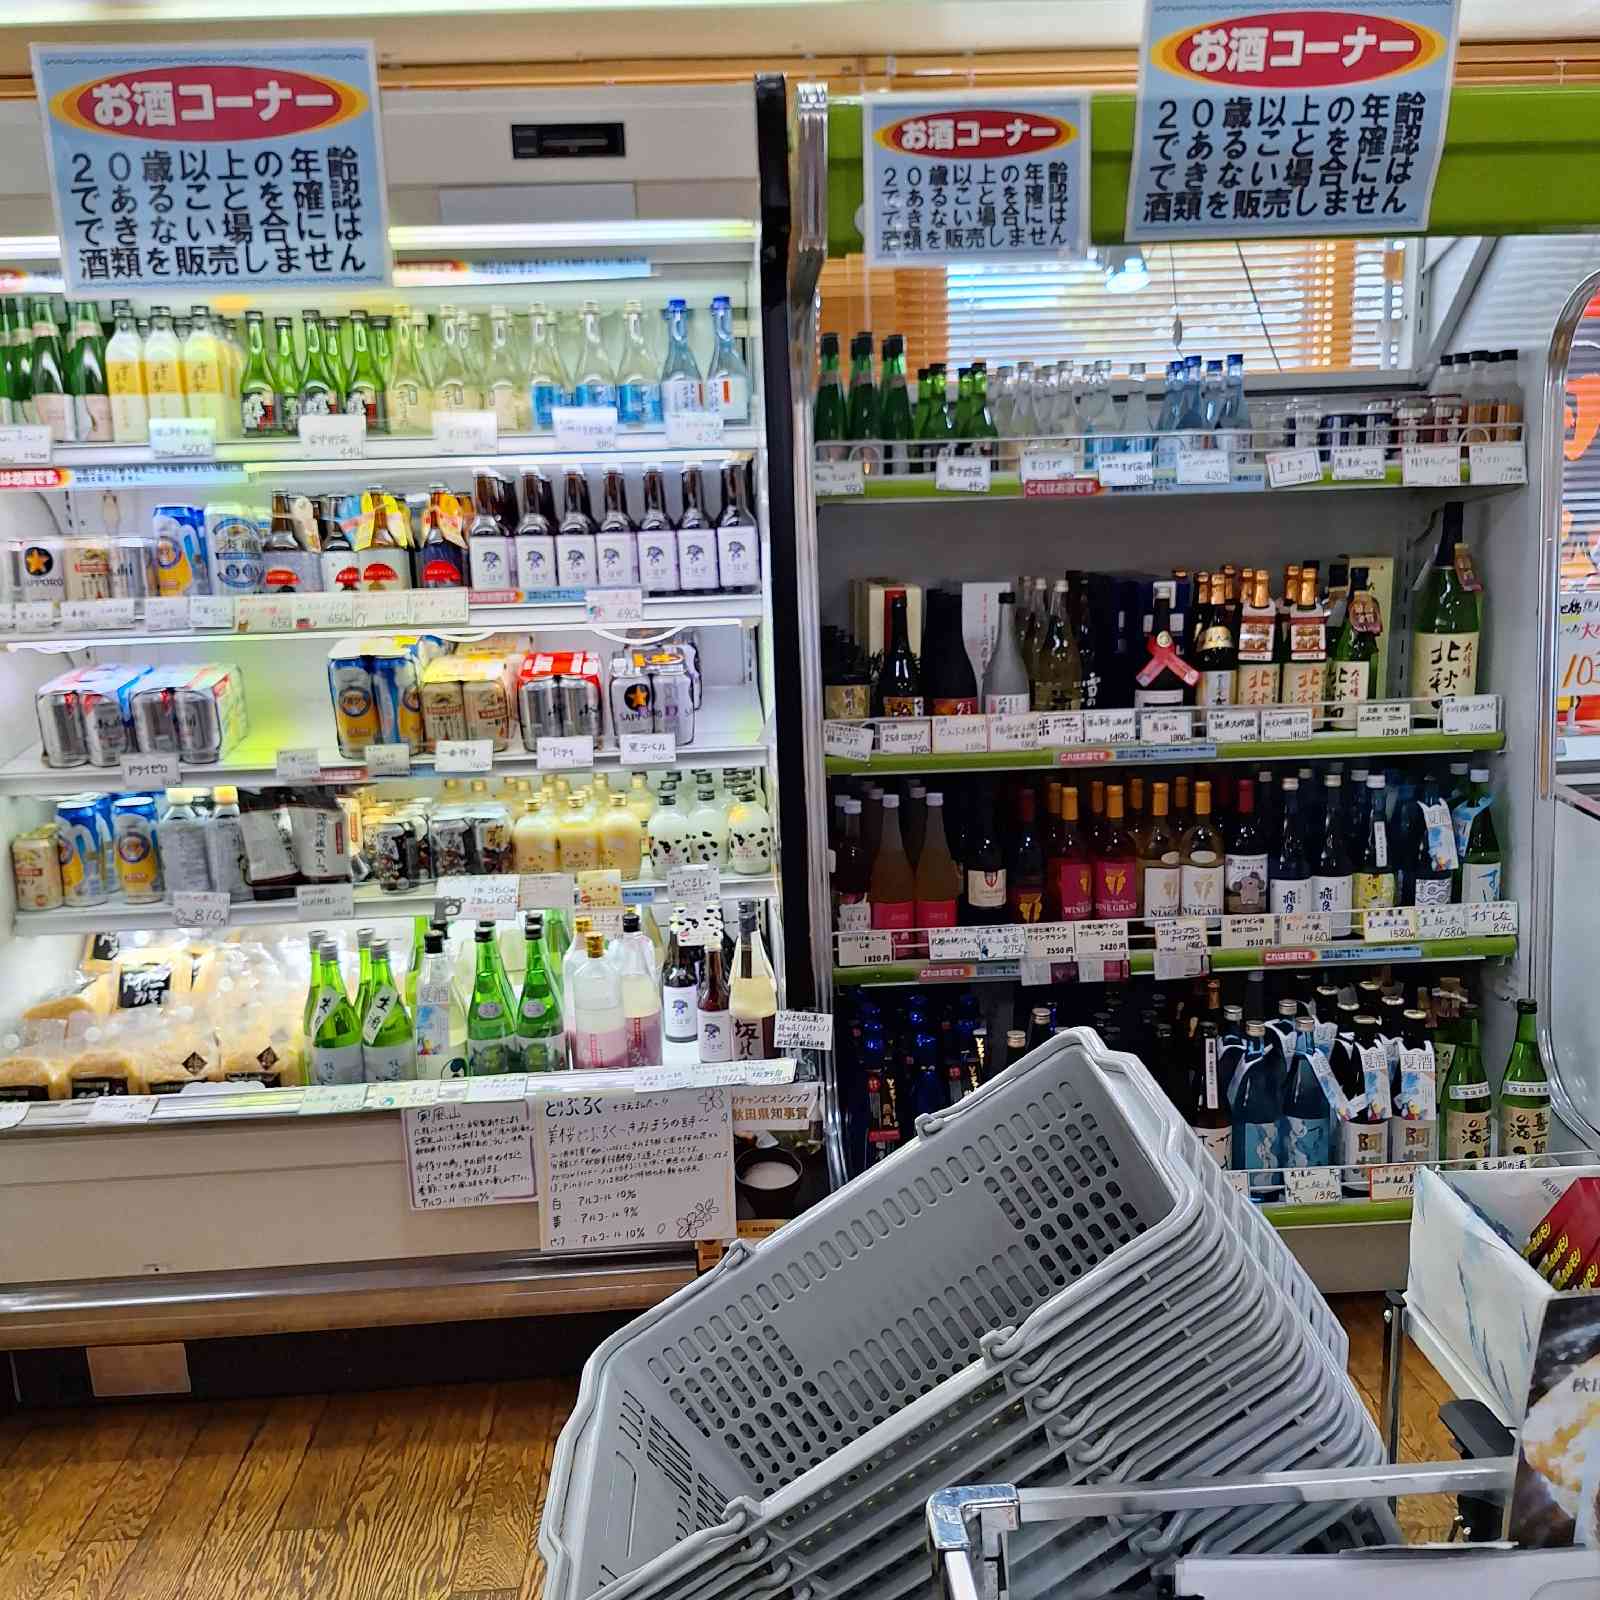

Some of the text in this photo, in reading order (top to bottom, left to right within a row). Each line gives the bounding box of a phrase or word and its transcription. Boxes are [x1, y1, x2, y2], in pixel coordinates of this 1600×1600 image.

[1189, 27, 1414, 73] お酒コーナー
[93, 81, 333, 127] お酒コーナー
[1159, 94, 1426, 130] 20歳以上の年齢
[902, 120, 1057, 151] お酒コーナー
[1153, 124, 1420, 160] であることを確認
[72, 146, 359, 183] 20歳以上の年齢
[1149, 156, 1412, 192] できない場合には
[71, 180, 361, 214] であることを確認
[882, 184, 1067, 207] であることを確認
[1144, 188, 1407, 222] 酒類を販売しません
[75, 213, 363, 245] できない場合には
[881, 205, 1067, 227] できない場合には
[881, 226, 1067, 251] 酒類を販売しません
[80, 246, 366, 279] 酒類を販売しません
[545, 1096, 604, 1119] どぶろく
